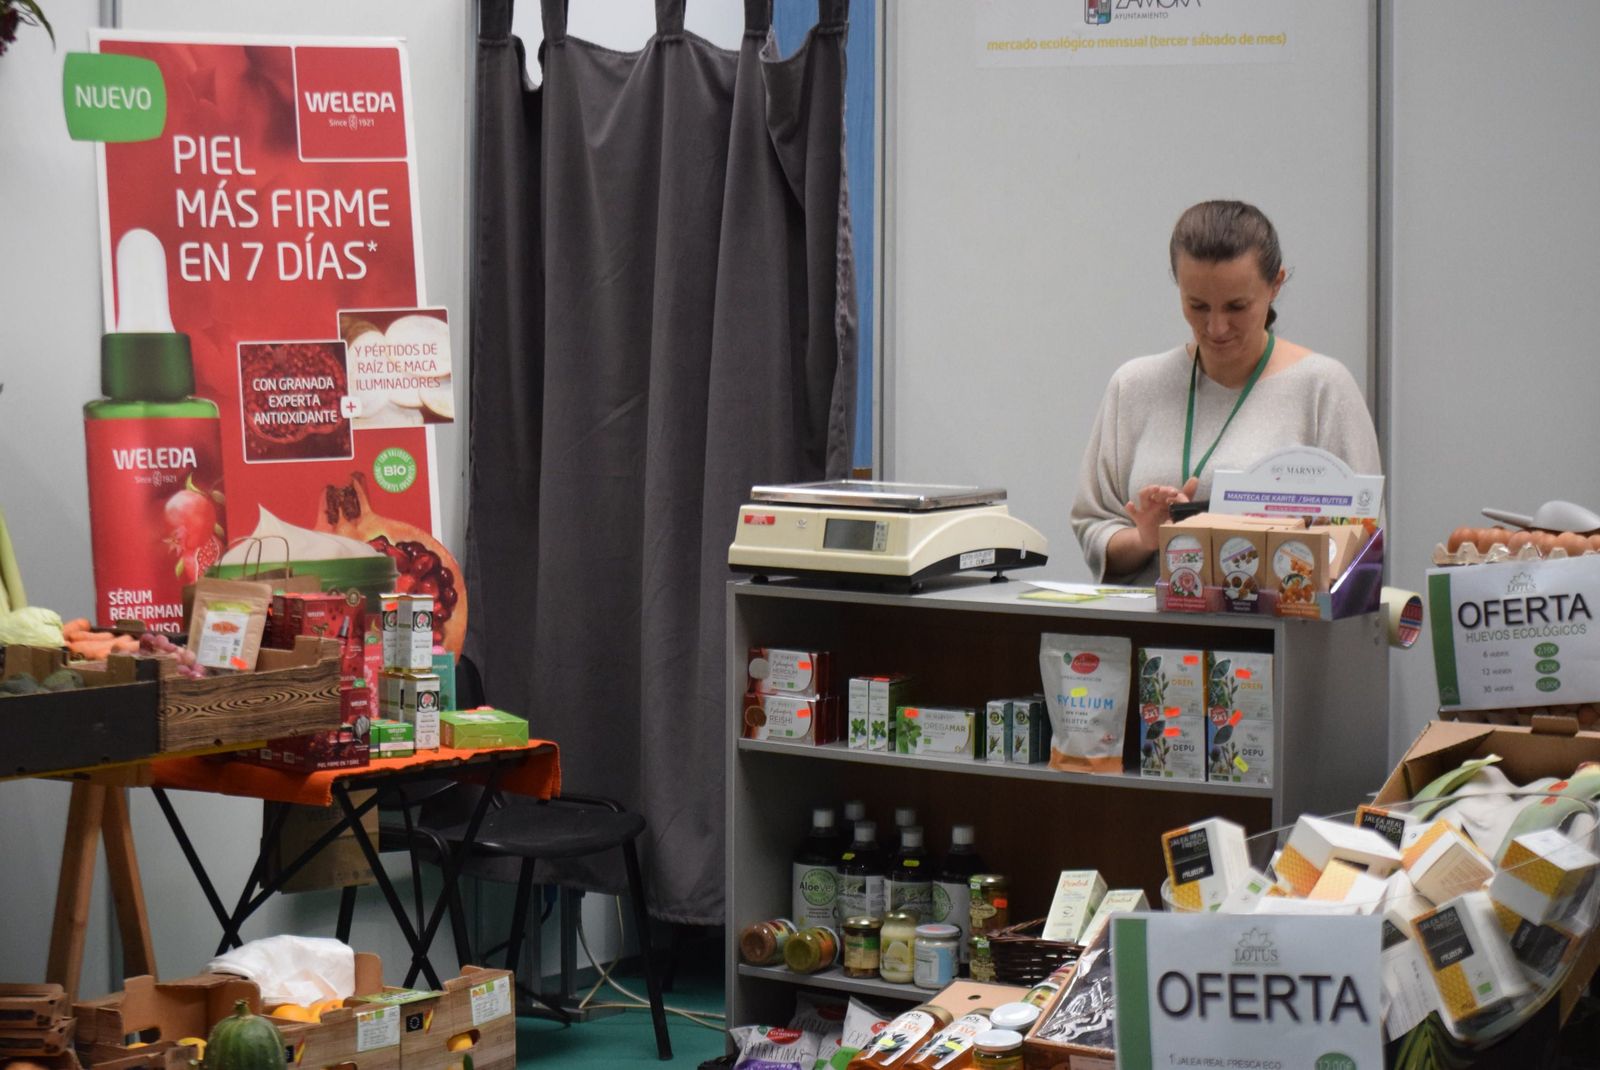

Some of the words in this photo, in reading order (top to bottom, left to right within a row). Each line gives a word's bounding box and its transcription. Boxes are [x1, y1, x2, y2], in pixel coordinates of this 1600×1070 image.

[1114, 12, 1169, 20] AYUNTAMIENTO
[986, 38, 1038, 50] mercado
[1039, 36, 1095, 52] ecológico
[1097, 35, 1148, 48] mensual
[1150, 35, 1189, 49] (tercer
[1192, 33, 1237, 47] sábado
[1239, 33, 1254, 46] de
[1256, 32, 1287, 48] mes)
[75, 85, 152, 111] NUEVO
[304, 91, 396, 114] WELEDA
[328, 118, 348, 127] Since
[358, 118, 375, 127] 1921
[173, 135, 257, 175] PIEL
[176, 180, 260, 229] MÁS
[270, 188, 391, 229] FIRME
[179, 241, 231, 282] EN
[241, 242, 264, 281] 7
[354, 345, 362, 356] Y
[364, 342, 418, 358] PÉPTIDOS
[420, 343, 438, 355] DE
[357, 359, 384, 374] RAÍZ
[386, 361, 402, 373] DE
[404, 361, 437, 373] MACA
[252, 377, 277, 392] CON
[278, 376, 335, 391] GRANADA
[355, 375, 441, 392] ILUMINADORES
[268, 394, 321, 408] EXPERTA
[253, 410, 339, 426] ANTIOXIDANTE
[112, 446, 198, 471] WELEDA
[162, 475, 177, 483] 1921
[1226, 492, 1261, 502] MANTECA
[1261, 494, 1271, 502] DE
[1321, 496, 1349, 505] BUTTER
[108, 587, 153, 605] SÉRUM
[109, 603, 184, 621] REAFIRMAN
[1458, 592, 1593, 630] OFERTA
[1466, 631, 1511, 643] HUEVOS
[1513, 623, 1587, 639] ECOLÓGICOS
[1172, 744, 1195, 752] DEPU
[1242, 748, 1264, 757] DEPU
[1234, 948, 1279, 962] LOTUS
[1157, 971, 1369, 1023] OFERTA
[1177, 1054, 1201, 1066] JALEA
[1203, 1055, 1225, 1068] REAL
[1227, 1056, 1262, 1069] FRESCA
[1263, 1058, 1283, 1070] ECO
